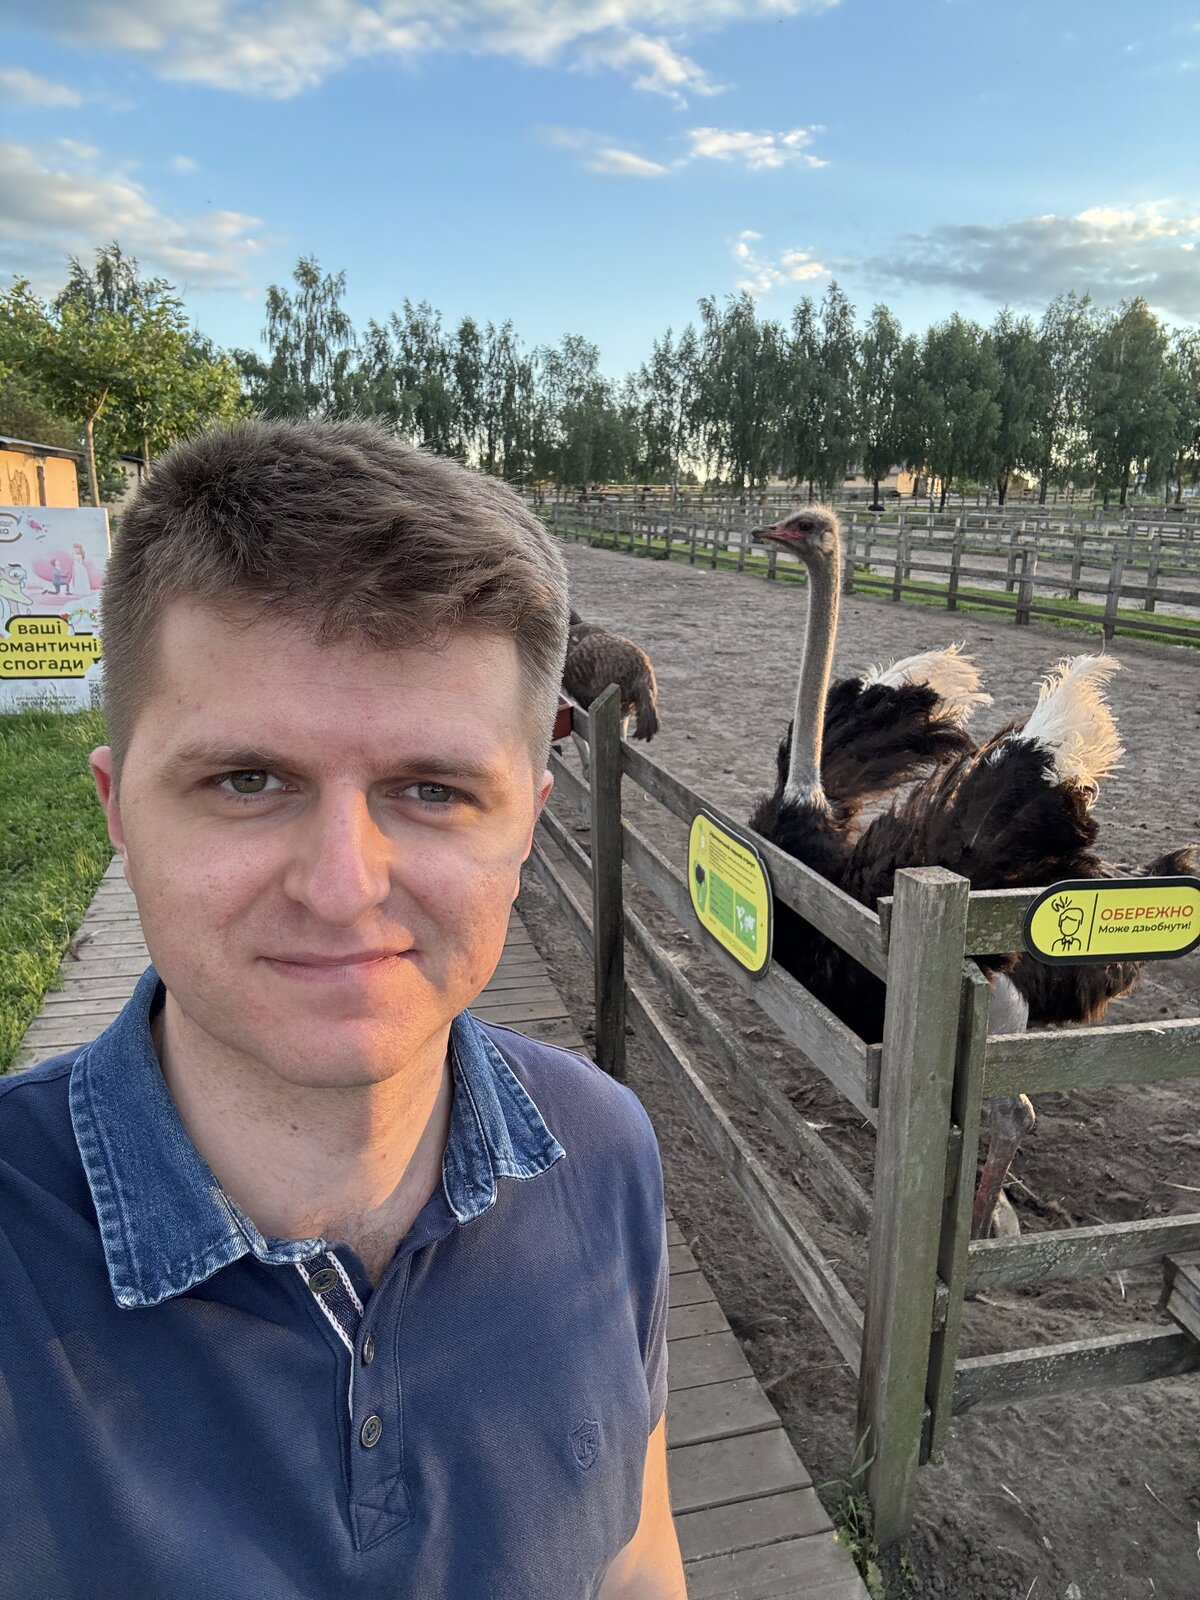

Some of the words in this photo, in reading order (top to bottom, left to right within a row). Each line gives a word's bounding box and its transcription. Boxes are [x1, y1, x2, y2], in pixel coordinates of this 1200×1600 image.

[18, 620, 62, 635] ваші
[0, 638, 98, 653] омантичні
[3, 659, 84, 672] спогади
[1101, 905, 1194, 920] ОБЕРЕЖНО
[1098, 924, 1130, 934] Може
[1132, 921, 1191, 933] дзьобнути!
